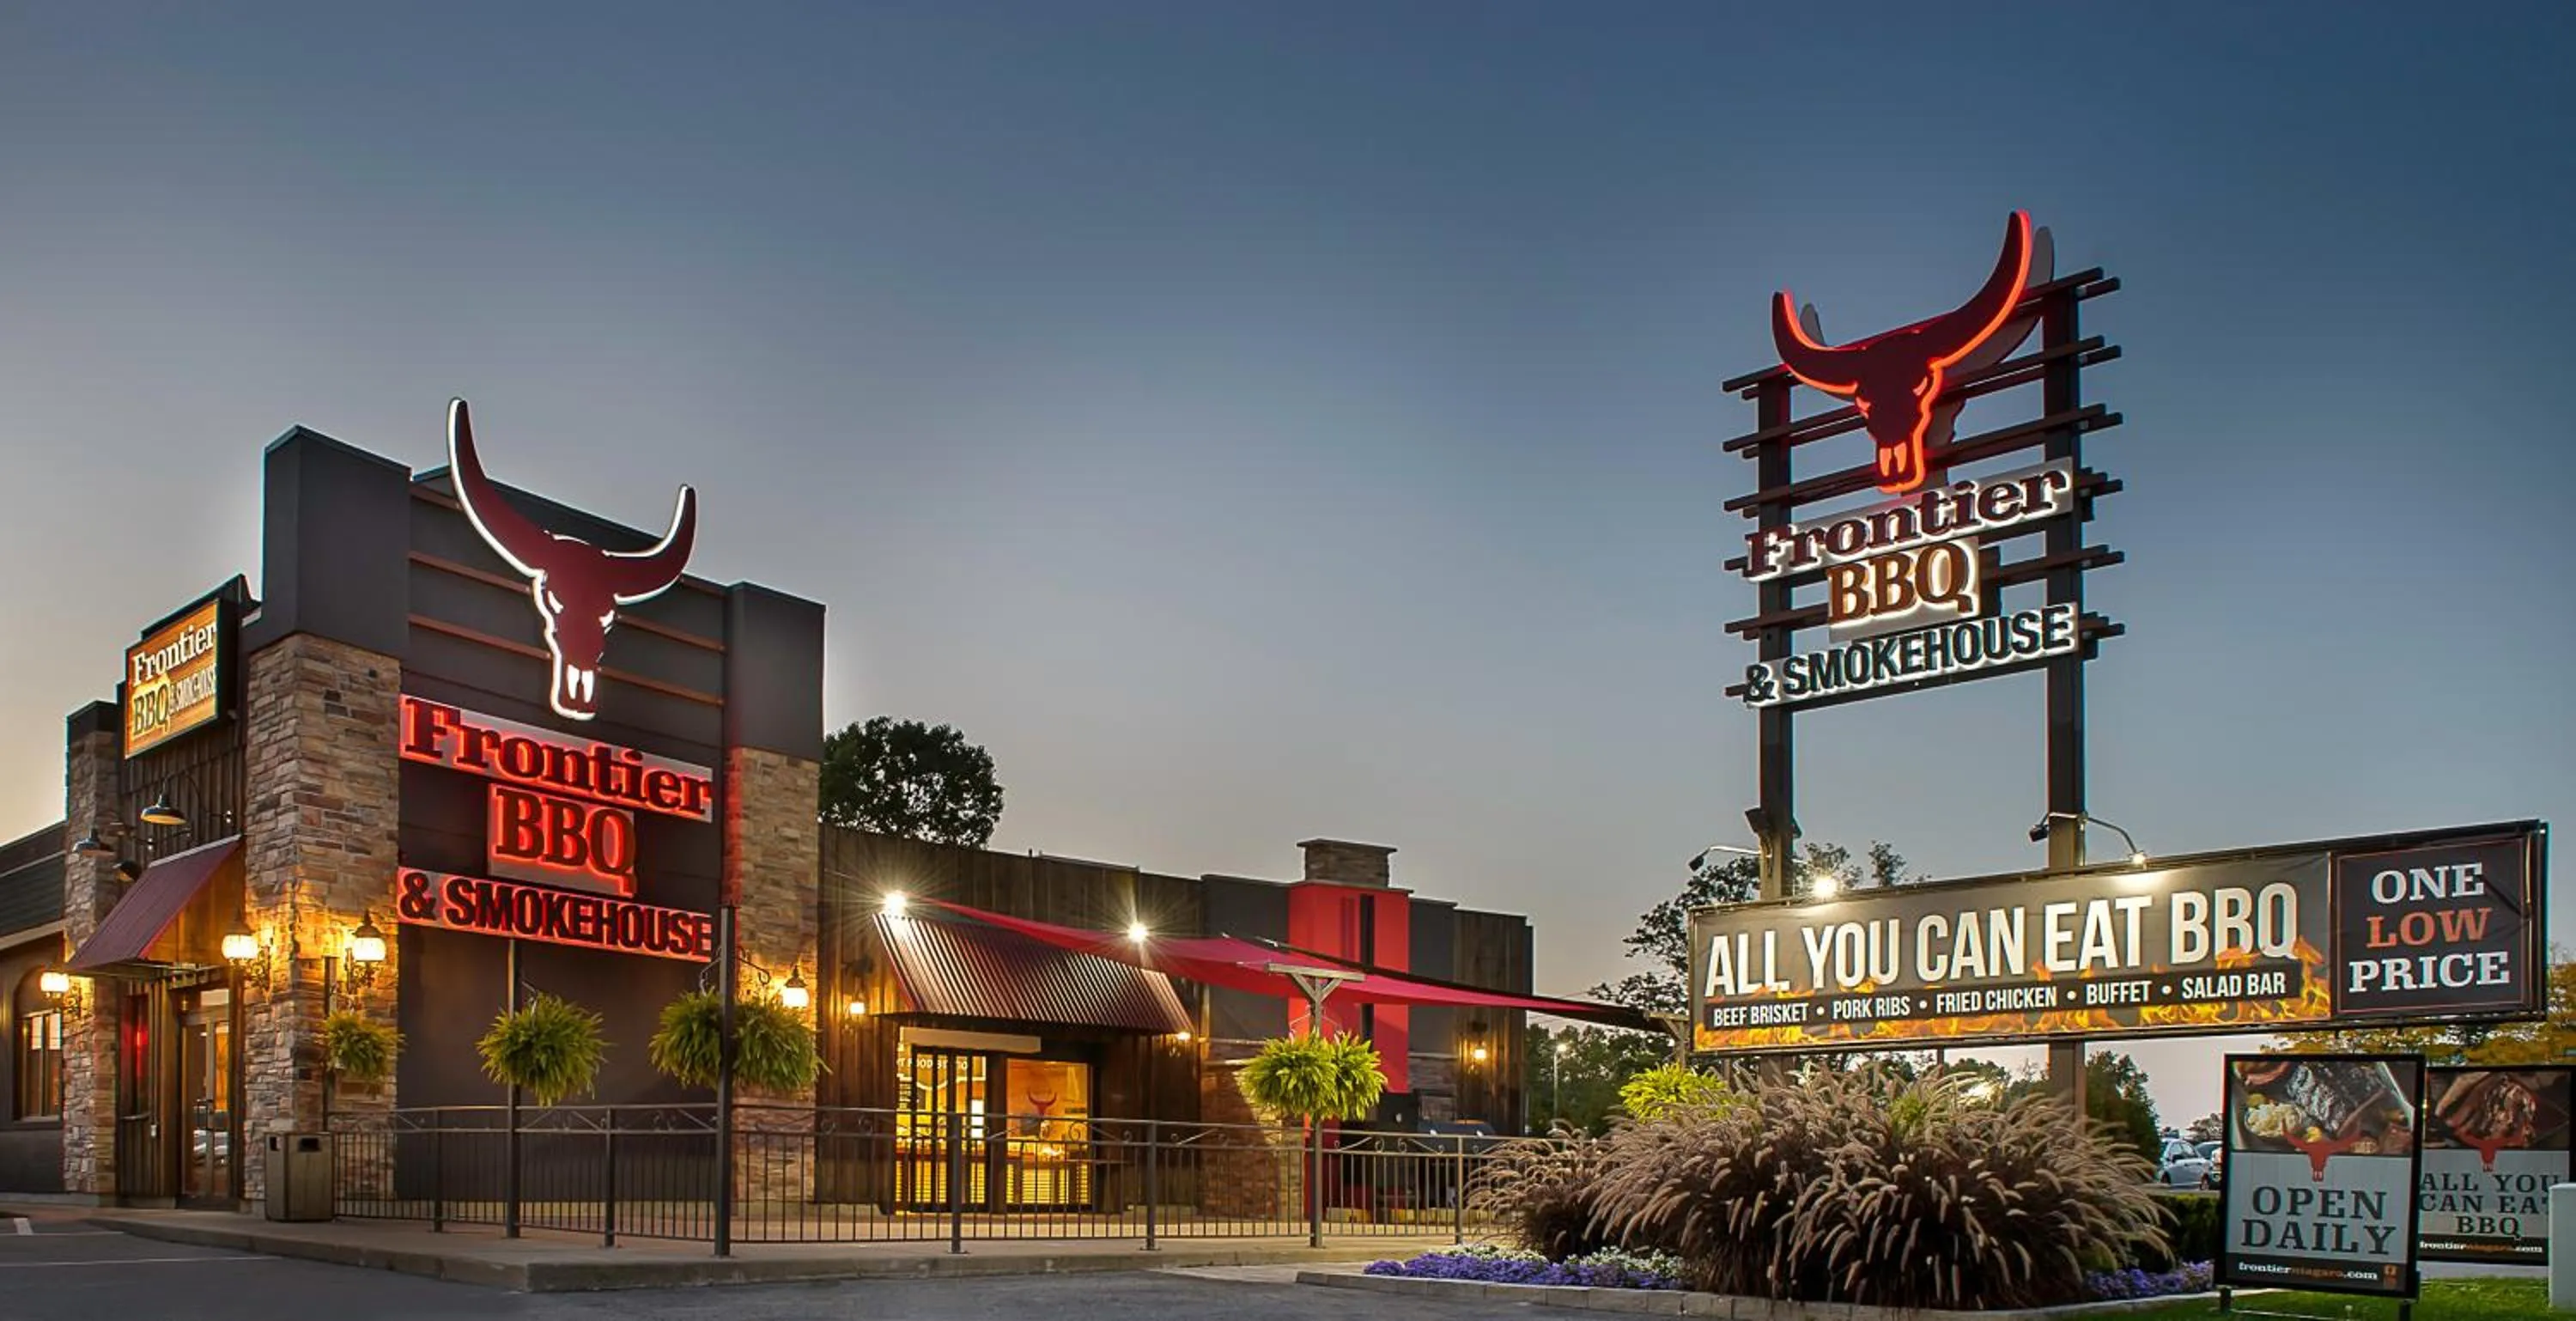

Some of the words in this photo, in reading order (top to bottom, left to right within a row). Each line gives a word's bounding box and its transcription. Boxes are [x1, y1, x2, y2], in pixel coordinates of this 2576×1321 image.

[1742, 470, 2068, 576] Frontier
[1826, 541, 1974, 625] BBQ
[133, 622, 216, 685] Frontier
[1743, 663, 1777, 704] &
[1784, 604, 2072, 696] SMOKEHOUSE
[133, 684, 170, 735] BBQ
[404, 697, 712, 815] Frontier
[495, 786, 637, 898] BBQ
[2371, 862, 2484, 904] ONE
[399, 872, 437, 922] &
[445, 878, 712, 957] SMOKEHOUSE
[1704, 930, 1790, 997] ALL
[1801, 919, 1900, 989] YOU
[1916, 906, 2026, 983] CAN
[2044, 895, 2153, 972] EAT
[2171, 882, 2299, 965] BBQ
[2366, 907, 2492, 948] LOW
[2348, 951, 2511, 994] PRICE
[1713, 1002, 1747, 1027] BEEF
[1750, 1001, 1809, 1025] BRISKET
[1832, 998, 1873, 1020] PORK
[1876, 995, 1911, 1018] RIBS
[1936, 991, 1981, 1014] FRIED
[1985, 985, 2057, 1011] CHICKEN
[2086, 980, 2153, 1005] BUFFET
[2182, 975, 2241, 1000] SALAD
[2246, 971, 2286, 996] BAR
[2252, 1185, 2387, 1221] OPEN
[2420, 1172, 2479, 1191] ALL
[2494, 1174, 2561, 1193] YOU
[2420, 1194, 2483, 1213] CAN
[2240, 1218, 2397, 1256] DAILY
[2456, 1215, 2521, 1239] BBQ
[2239, 1262, 2378, 1281] frontierniagara.com
